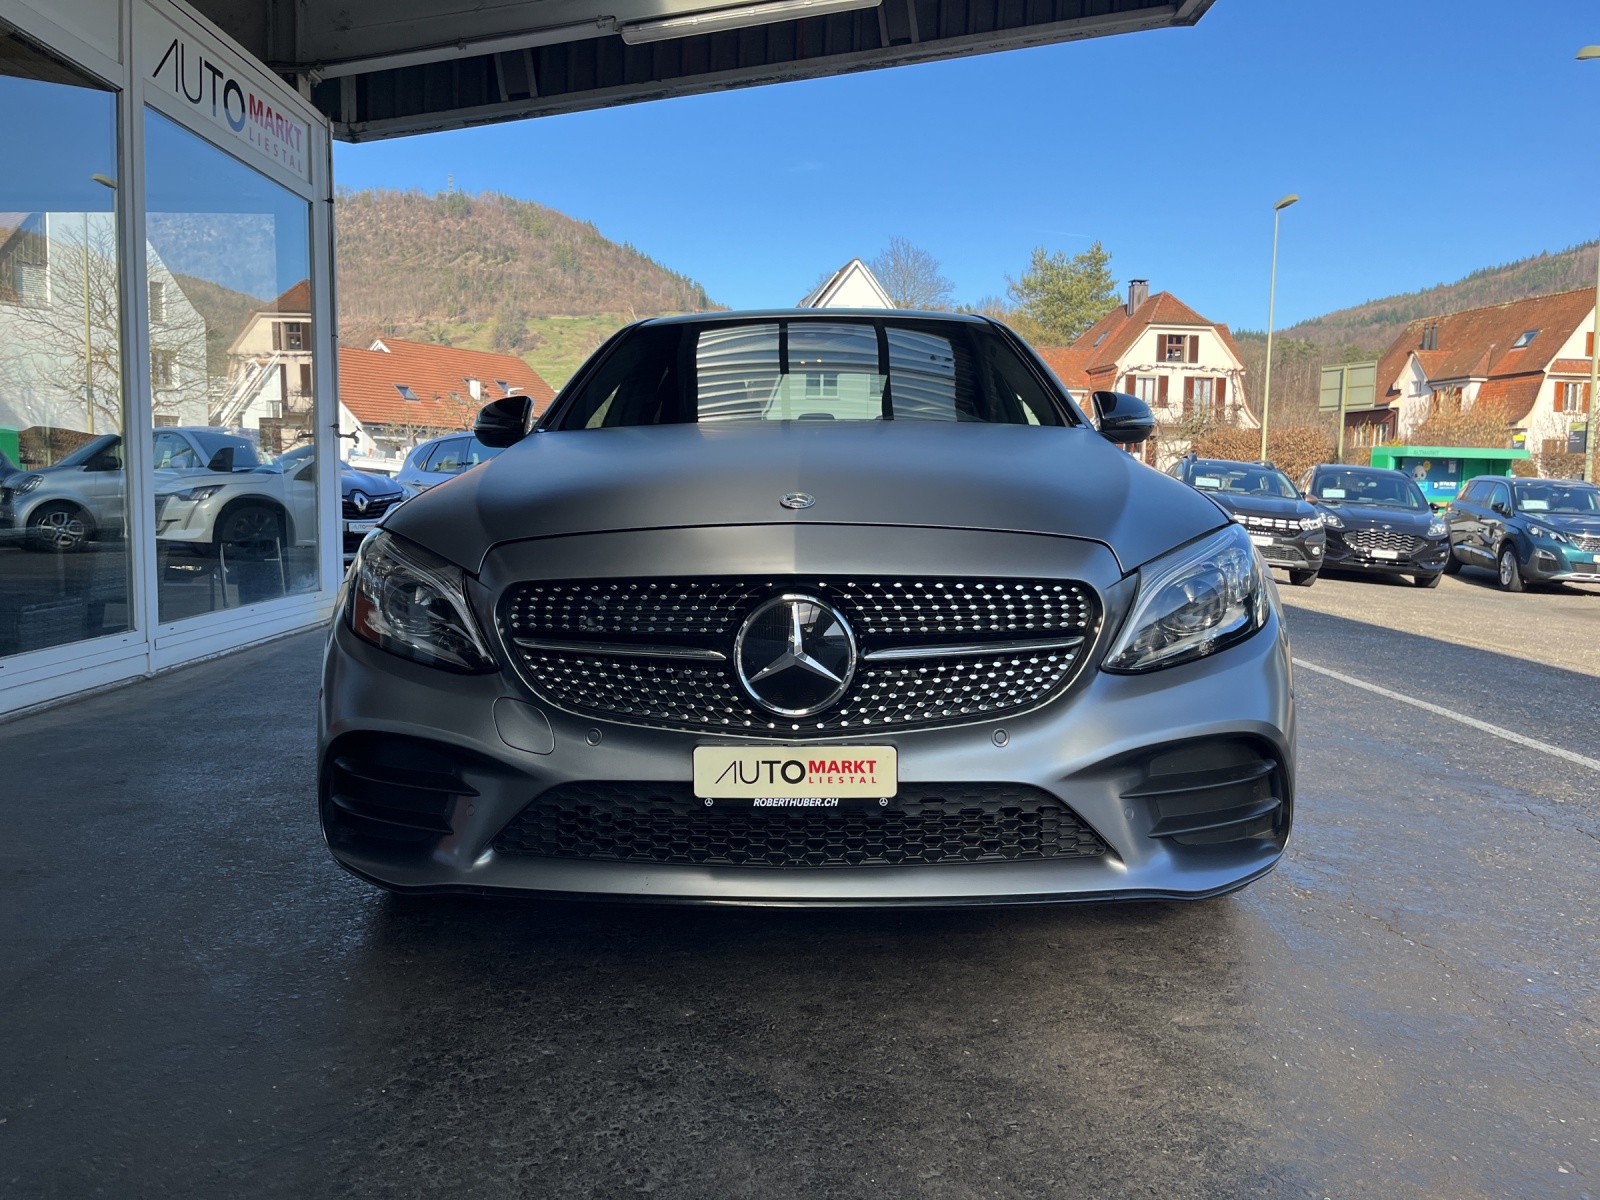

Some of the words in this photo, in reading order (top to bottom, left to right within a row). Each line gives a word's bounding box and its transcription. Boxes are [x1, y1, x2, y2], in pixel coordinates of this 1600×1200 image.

[152, 38, 246, 133] AUTO
[249, 92, 302, 152] MARKT
[249, 127, 303, 173] LIESTAL
[715, 759, 806, 784] AUTO
[808, 760, 877, 774] MARKT
[808, 776, 877, 784] LIESTAL
[753, 798, 839, 807] ROBERTHUBER.CH
